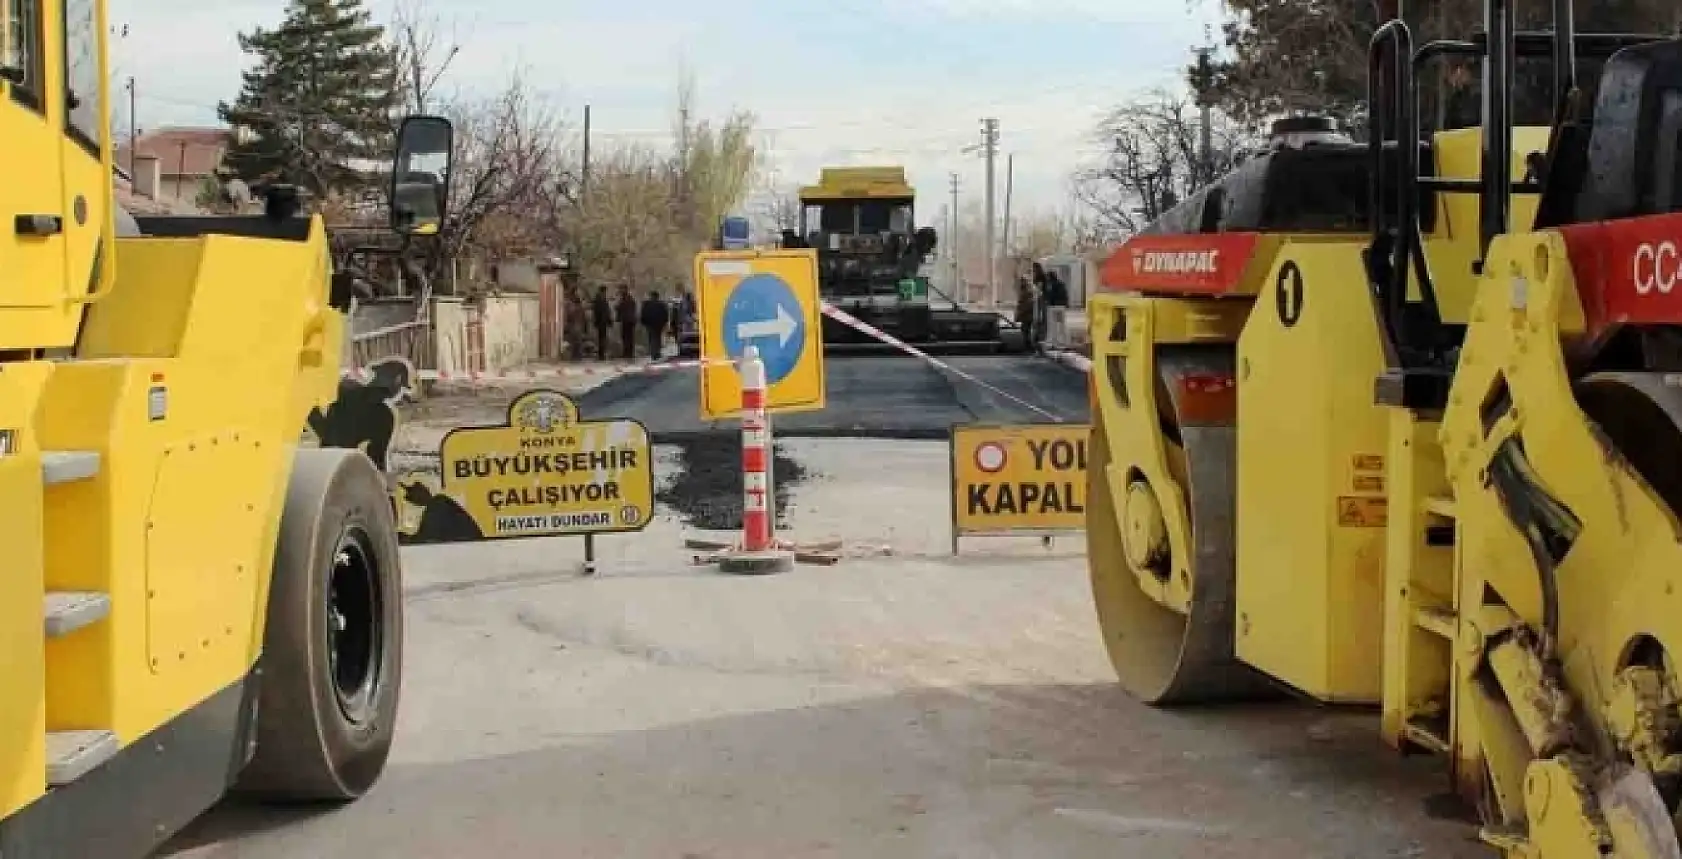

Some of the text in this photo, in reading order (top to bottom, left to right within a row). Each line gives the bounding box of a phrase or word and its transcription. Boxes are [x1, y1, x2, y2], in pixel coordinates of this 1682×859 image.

[1144, 250, 1220, 274] DYNAPAC
[519, 436, 576, 447] KONYA
[455, 445, 637, 478] BÜYÜKŞEHİR
[488, 481, 621, 512] ÇALIŞIYOR
[968, 482, 1084, 515] KAPAL
